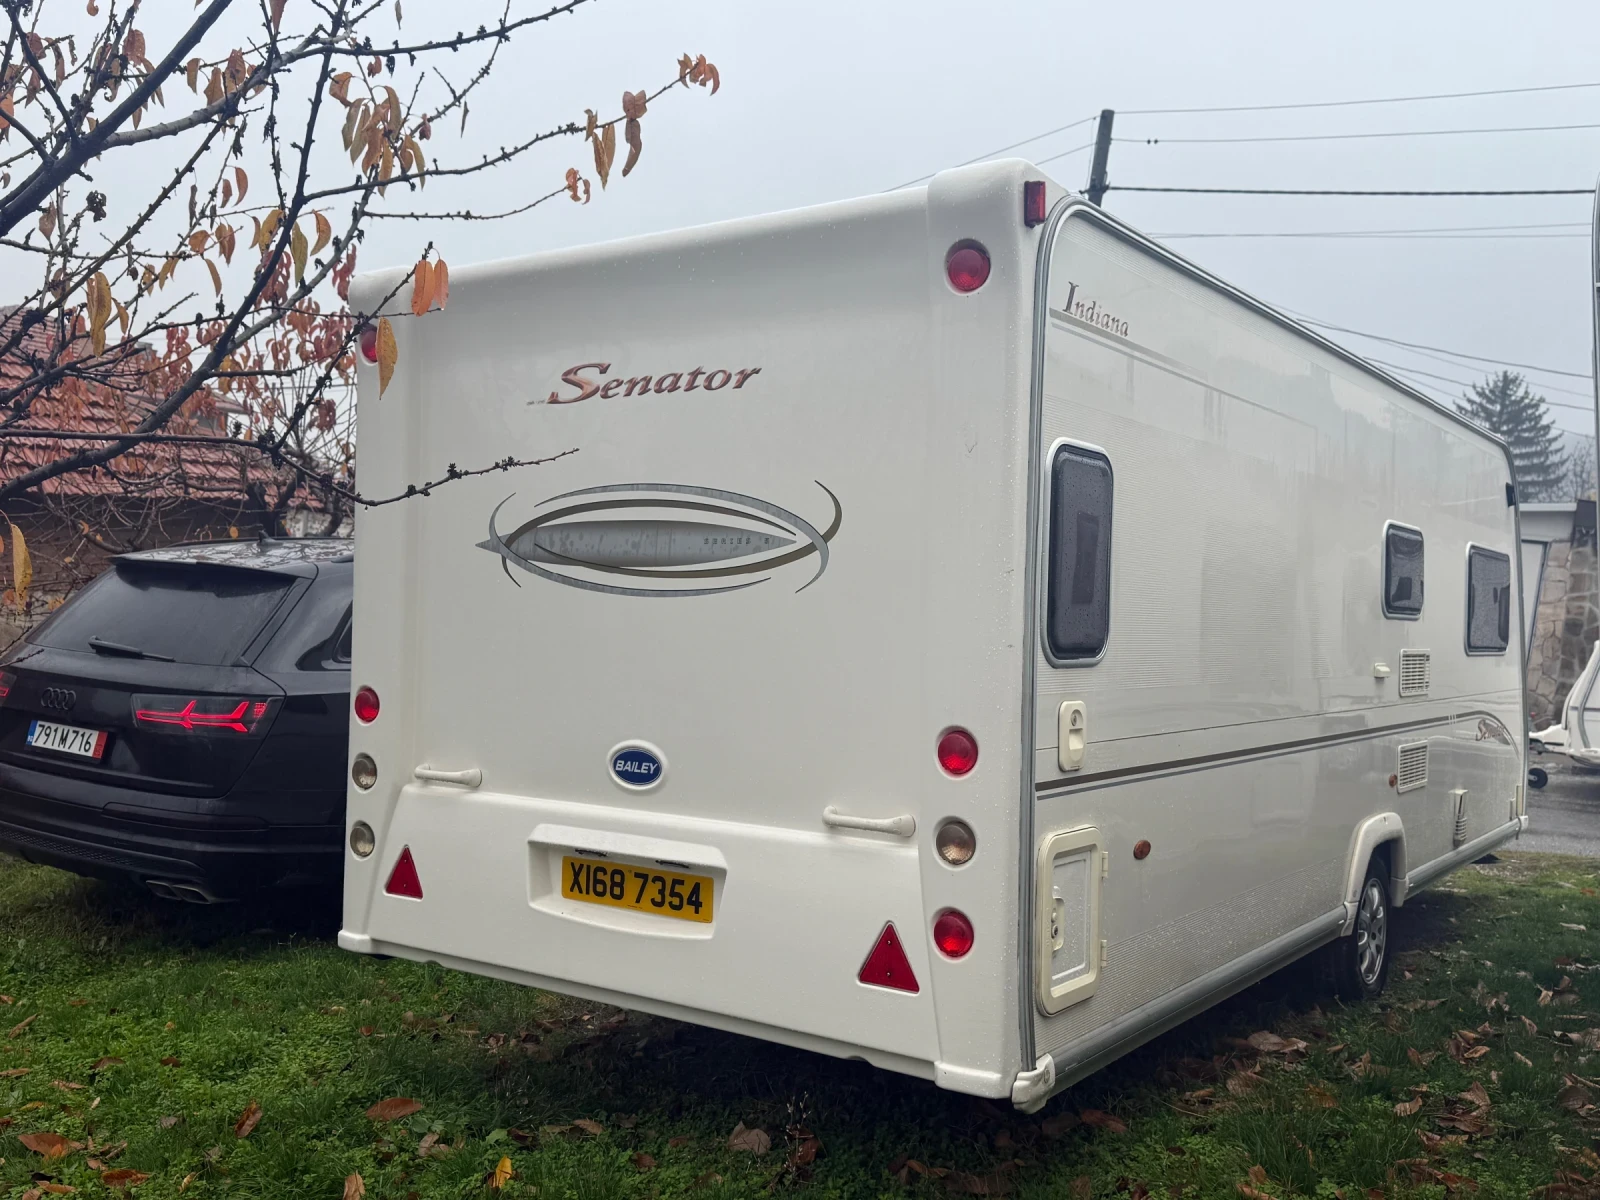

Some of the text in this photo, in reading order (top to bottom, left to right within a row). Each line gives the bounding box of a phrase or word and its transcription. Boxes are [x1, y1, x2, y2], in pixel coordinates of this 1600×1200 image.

[1062, 281, 1129, 338] Indiana
[546, 362, 763, 405] Senator
[34, 723, 93, 753] 791M716
[615, 760, 658, 774] BAILEY
[634, 871, 703, 915] 7354
